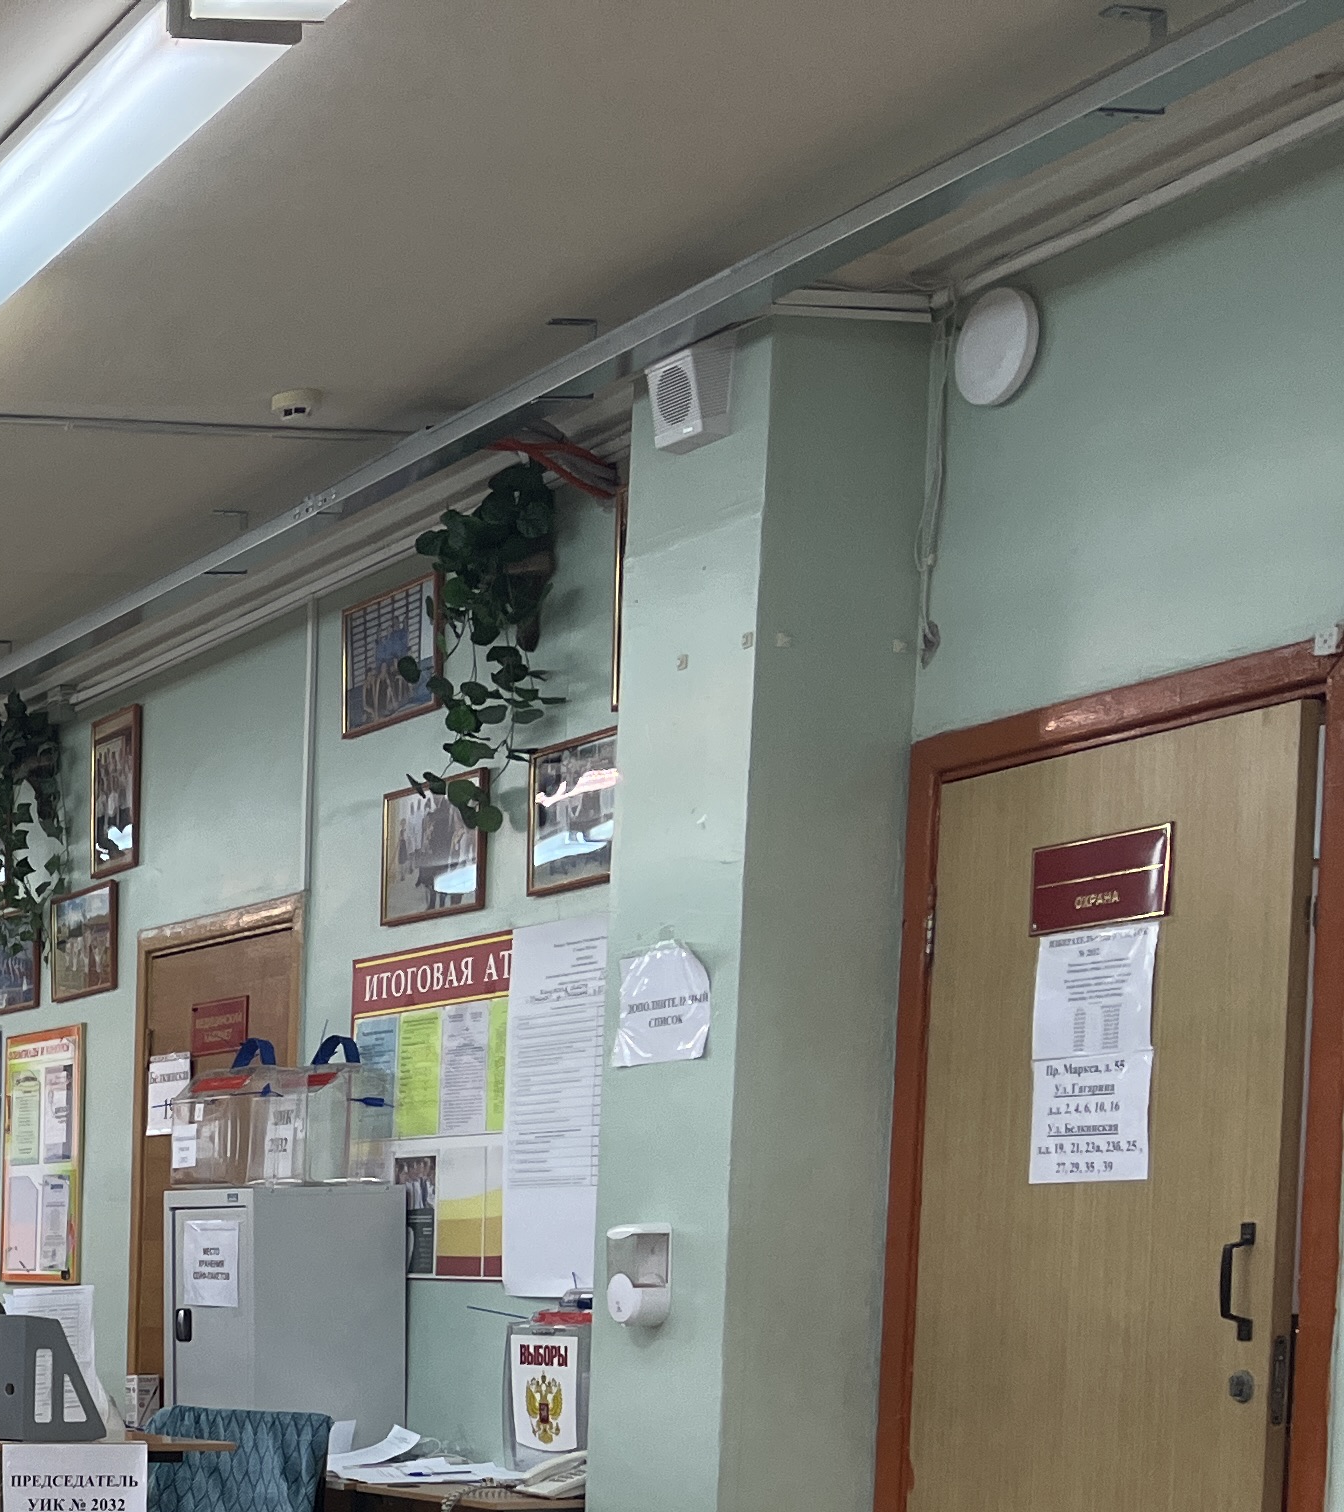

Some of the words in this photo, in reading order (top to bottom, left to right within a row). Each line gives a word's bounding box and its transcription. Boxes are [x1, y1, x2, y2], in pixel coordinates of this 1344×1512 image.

[1074, 889, 1120, 910] ОХРАНА
[364, 956, 474, 1001] ИТОГОВАЯ
[648, 1014, 683, 1028] СПИСОК
[1110, 1101, 1120, 1112] 16
[1103, 1161, 1113, 1172] 39
[520, 1343, 568, 1367] ВЫБОРЫ
[11, 1474, 138, 1489] ПРЕДСЕДАТЕЛЬ
[28, 1499, 64, 1512] УИК
[68, 1499, 86, 1512] №
[91, 1498, 125, 1512] 2032
